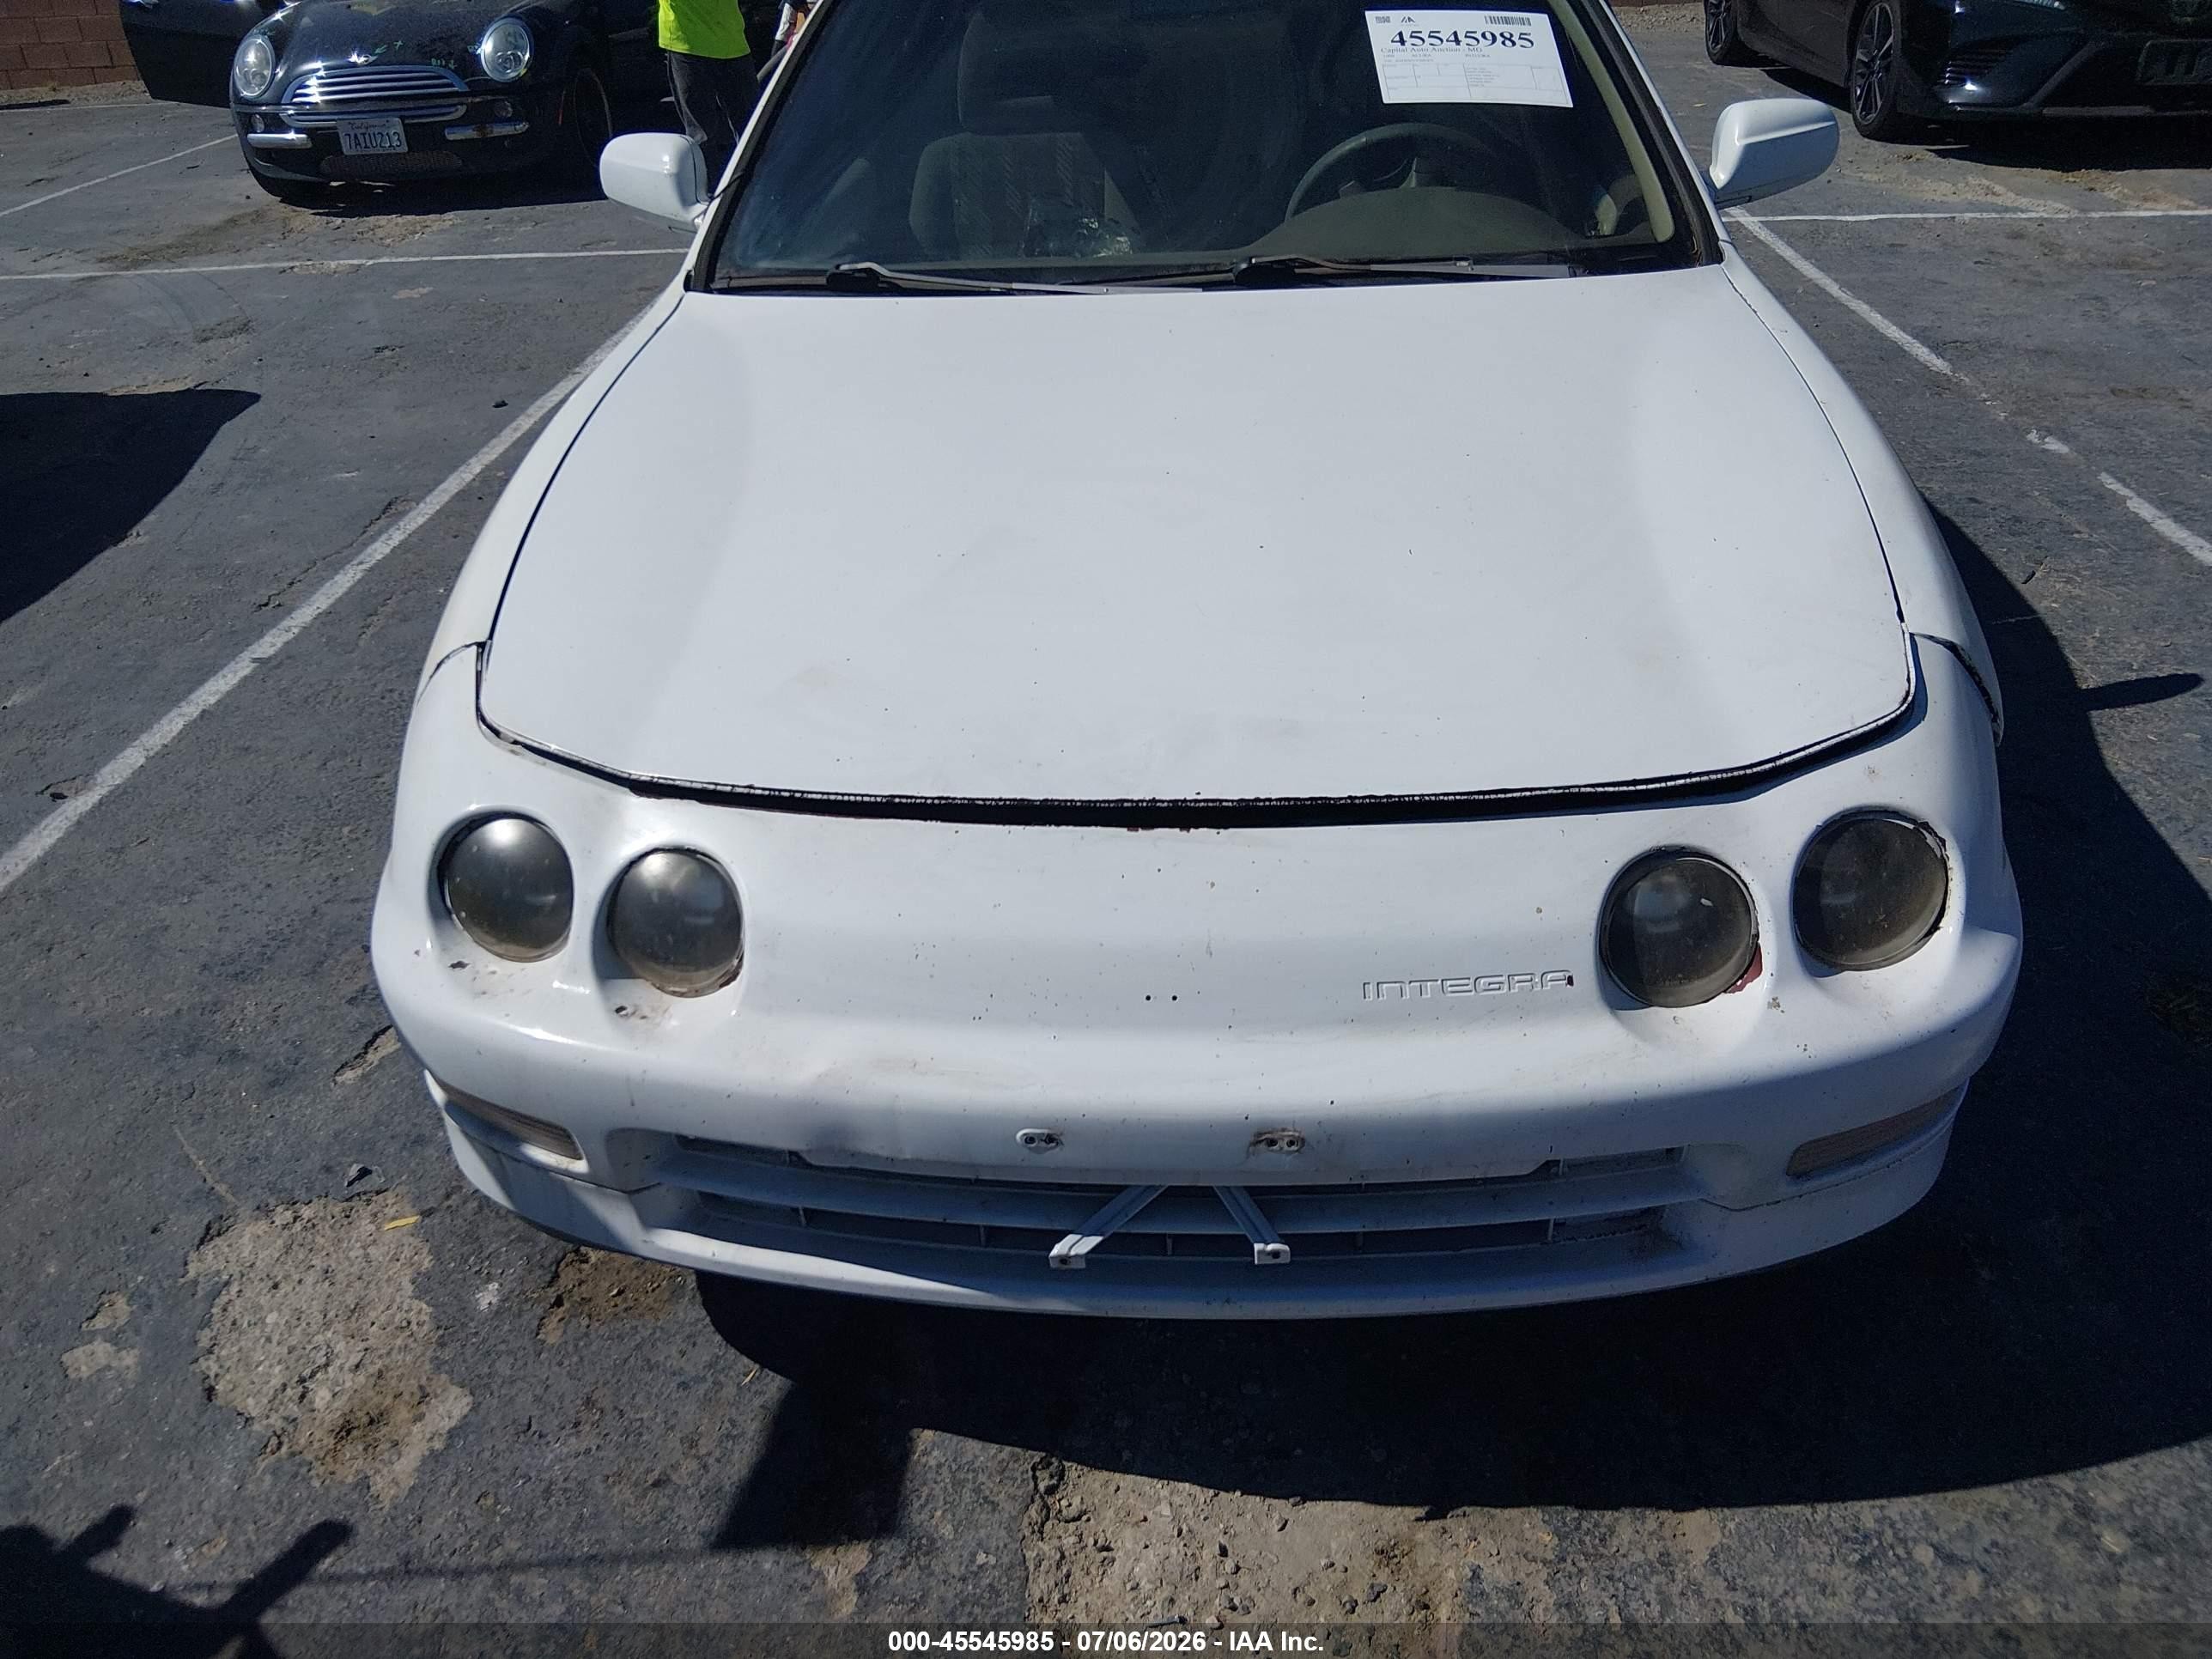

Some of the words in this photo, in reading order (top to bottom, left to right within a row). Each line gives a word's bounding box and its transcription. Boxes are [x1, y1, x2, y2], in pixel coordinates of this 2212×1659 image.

[1390, 29, 1534, 49] 45545985
[343, 131, 403, 149] 7AIU213
[1363, 969, 1573, 1001] INTEGRA
